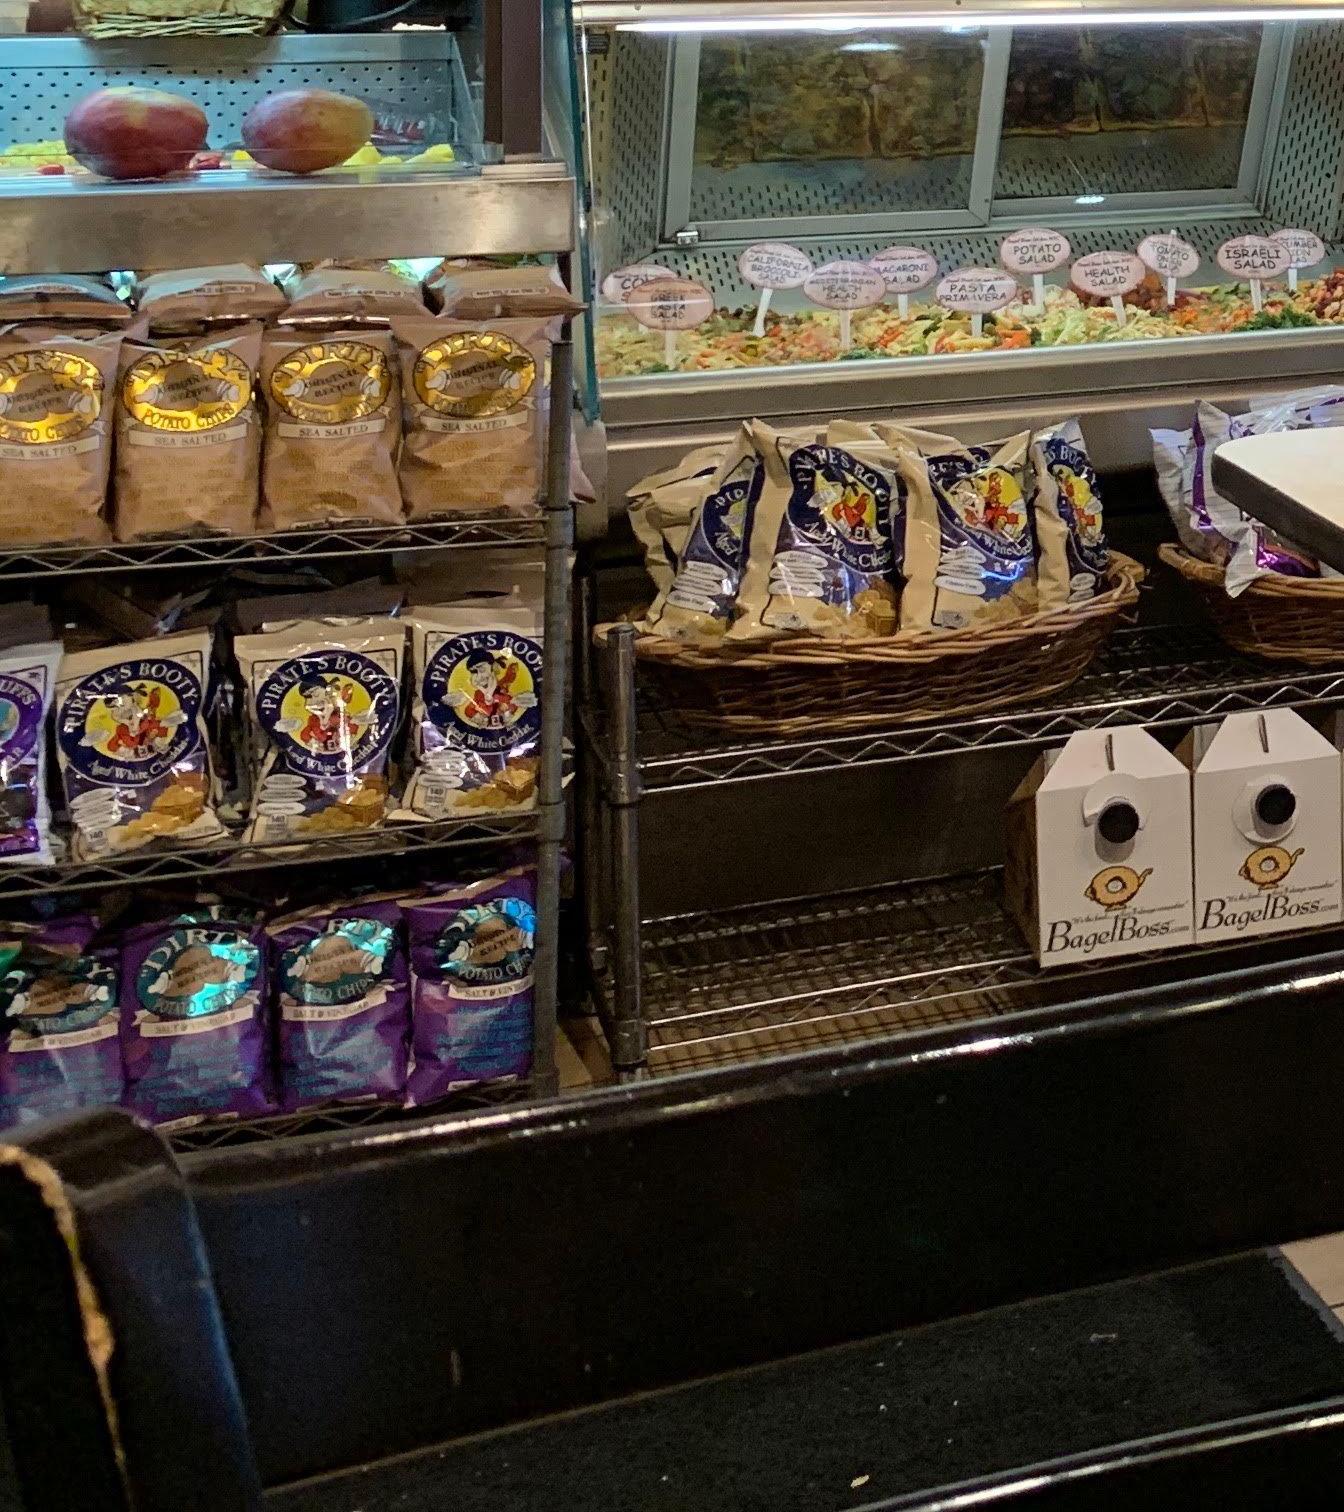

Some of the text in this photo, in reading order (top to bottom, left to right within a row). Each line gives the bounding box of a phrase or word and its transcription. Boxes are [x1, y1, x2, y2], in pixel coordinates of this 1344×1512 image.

[1013, 243, 1062, 255] POTATO
[1224, 247, 1282, 260] ISRAELI
[747, 254, 810, 272] CALIFORNIA
[1017, 253, 1056, 264] SALAD
[1233, 257, 1276, 271] SALAD
[1084, 265, 1131, 278] HEALTH
[1090, 274, 1127, 287] SALAD
[949, 283, 996, 294] PASTA
[938, 291, 1007, 304] PRIMAVERA
[142, 409, 191, 430] POTATO
[441, 419, 507, 431] SEA SALTED
[299, 424, 368, 437] SEA SALTED
[155, 432, 228, 446] SEA SALTED
[30, 445, 77, 457] SALTED
[430, 633, 498, 681] PIRATE'S
[261, 653, 394, 710] PIRATE'S BOOTY
[64, 664, 132, 733] PIRATE'S
[139, 662, 199, 700] BOOTY
[467, 735, 498, 750] White
[115, 768, 150, 782] White
